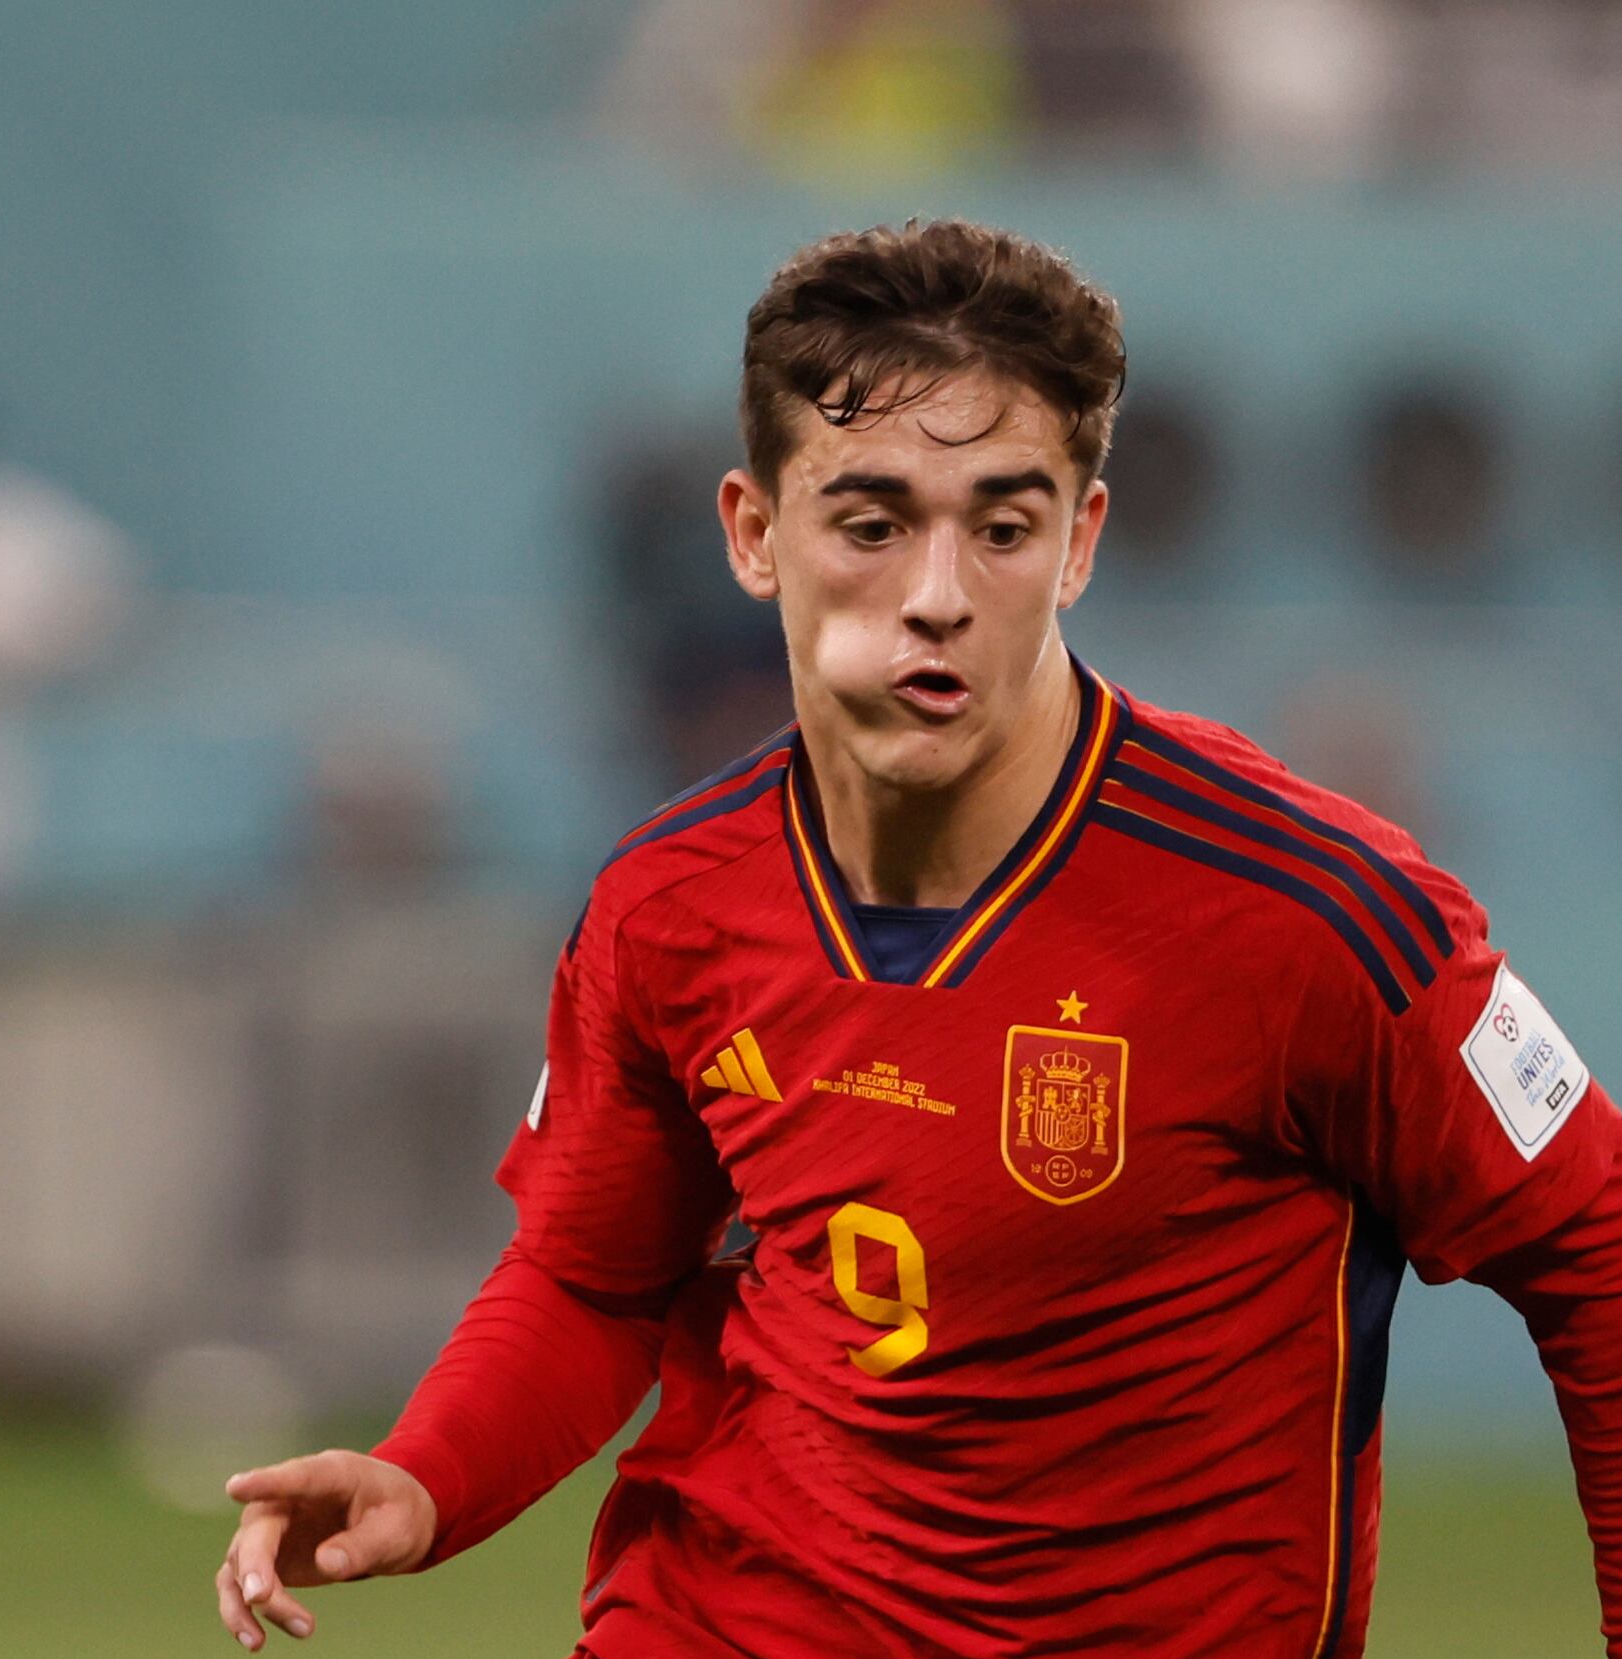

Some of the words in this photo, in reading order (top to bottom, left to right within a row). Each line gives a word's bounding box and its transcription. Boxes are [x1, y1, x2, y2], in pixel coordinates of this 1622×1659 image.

[842, 1070, 853, 1082] 01
[856, 1072, 900, 1090] DECEMBER
[902, 1080, 926, 1096] 2022
[872, 1061, 899, 1077] JAPAN
[1517, 1038, 1554, 1090] UNITES
[812, 1078, 849, 1095] KHALIFA
[852, 1084, 915, 1108] INTERNATIONAL
[917, 1097, 956, 1116] STADIUM
[828, 1202, 928, 1377] 9
